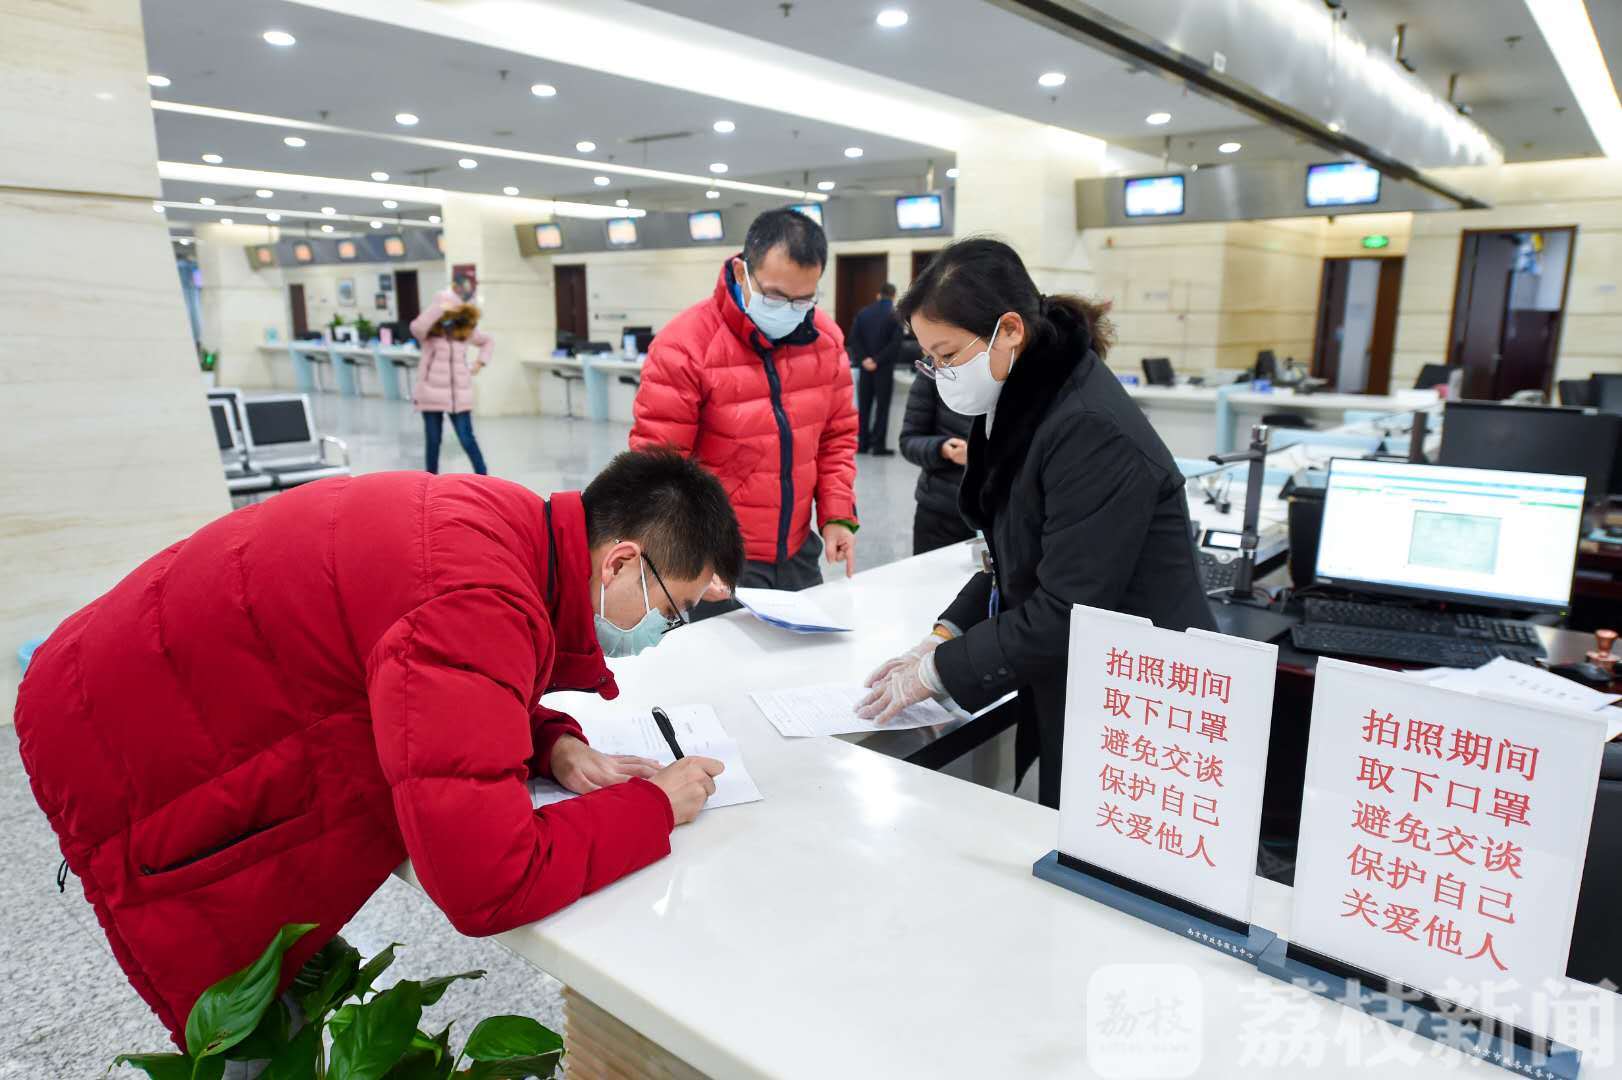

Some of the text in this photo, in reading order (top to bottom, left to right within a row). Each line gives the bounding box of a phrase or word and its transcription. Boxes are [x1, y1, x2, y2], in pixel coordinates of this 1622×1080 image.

[1106, 647, 1232, 704] 拍照期间
[1103, 687, 1229, 743] 取下口罩
[1362, 709, 1540, 782] 拍照期间
[1100, 725, 1225, 787] 避免交谈
[1098, 764, 1219, 826] 保护自己
[1356, 755, 1533, 828] 取下口罩
[1096, 803, 1216, 868] 关爱他人
[1351, 800, 1524, 879] 避免交谈
[1346, 844, 1516, 925] 保护自己
[1341, 889, 1508, 971] 关爱他人
